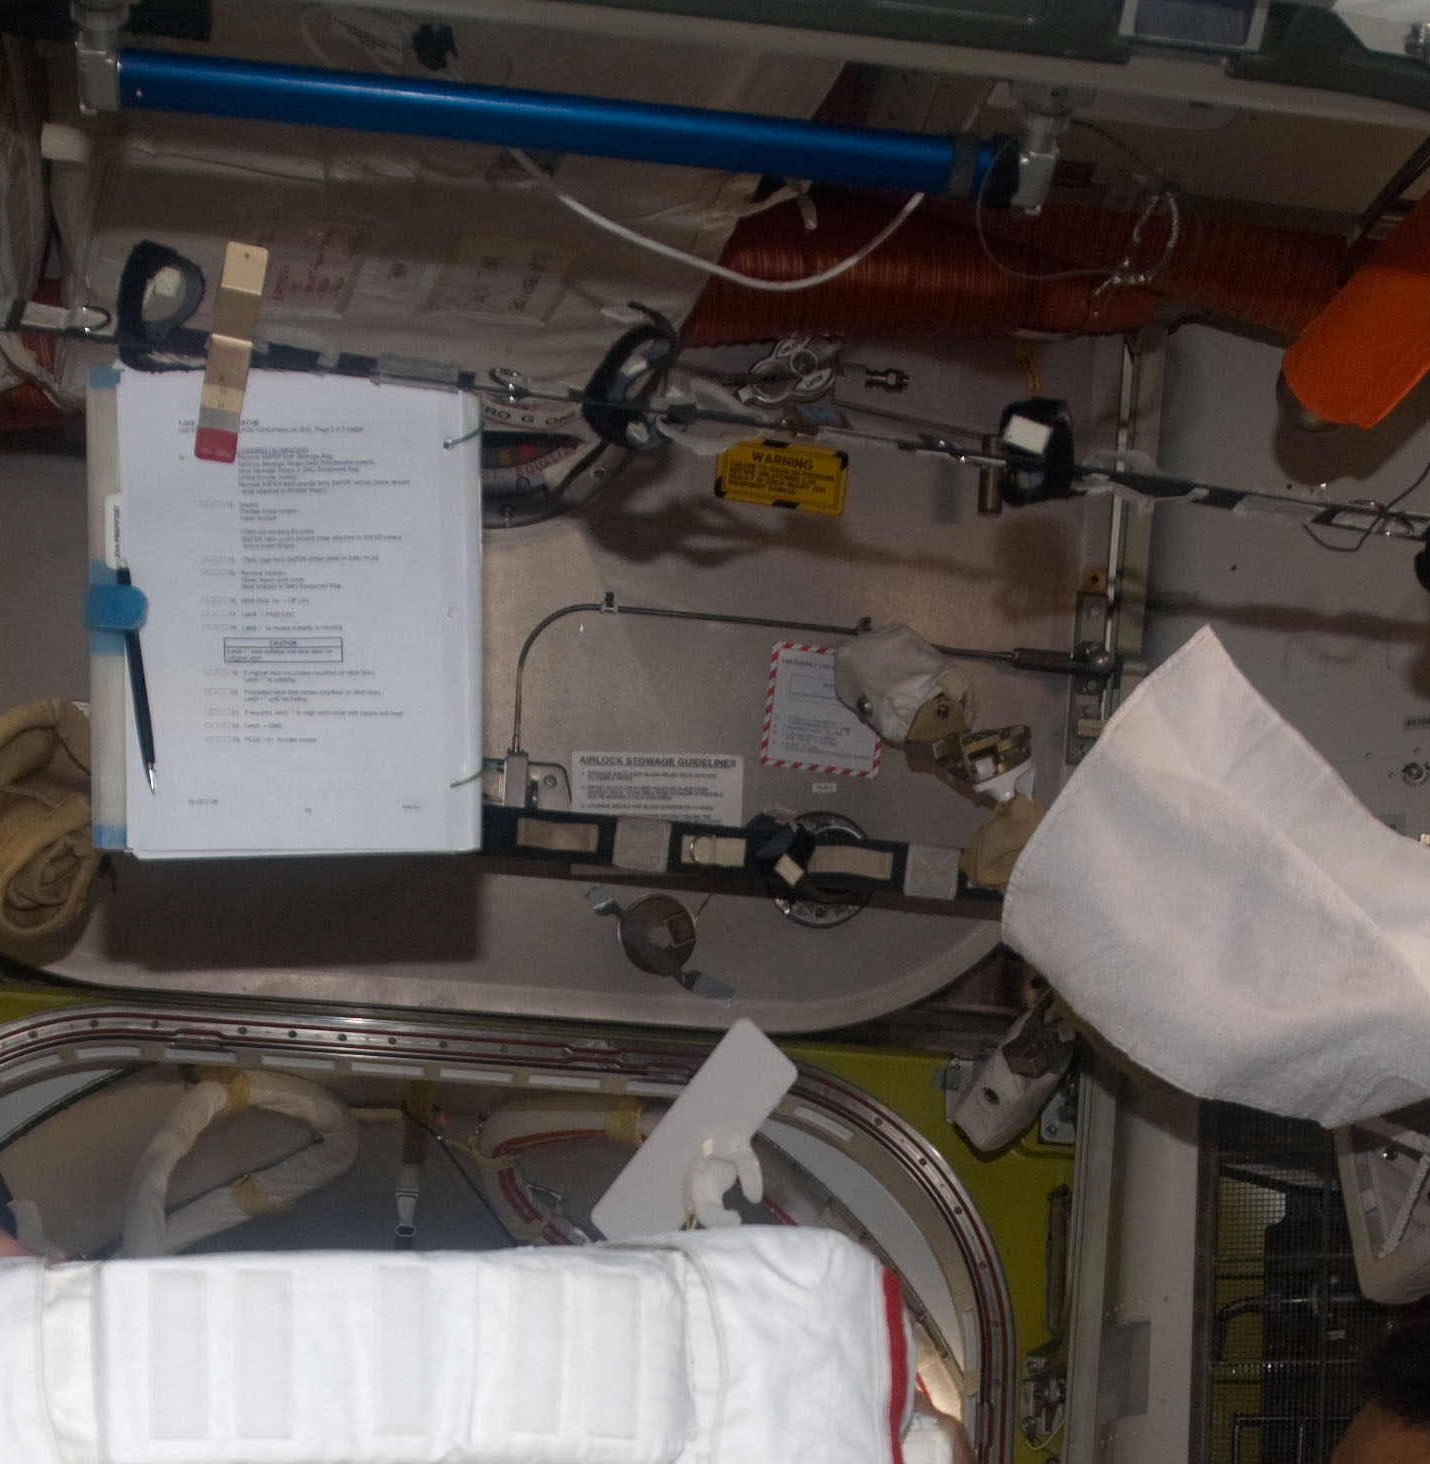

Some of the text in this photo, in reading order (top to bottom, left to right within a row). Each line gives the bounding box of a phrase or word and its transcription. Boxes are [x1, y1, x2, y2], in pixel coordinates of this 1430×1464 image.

[752, 451, 813, 470] WARNING
[579, 756, 737, 769] AIRLOCK STOWAGE GUIDELINES
